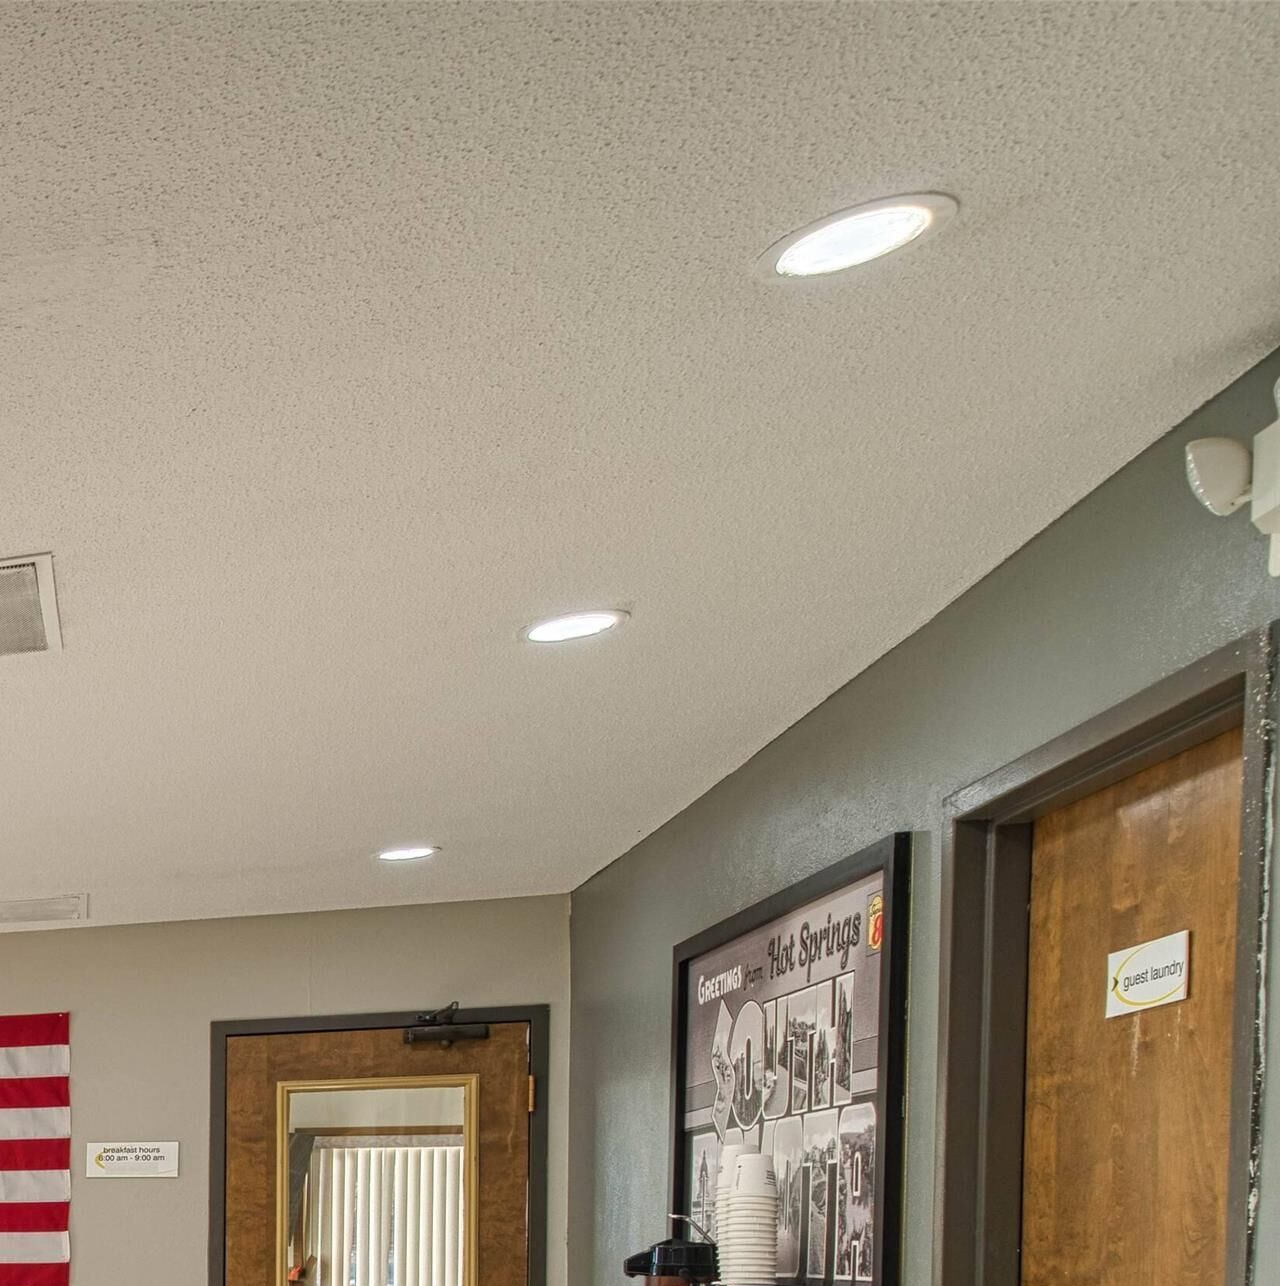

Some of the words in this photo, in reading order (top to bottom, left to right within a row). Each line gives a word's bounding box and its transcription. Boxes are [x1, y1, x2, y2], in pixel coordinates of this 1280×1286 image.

[698, 965, 742, 1005] GREETINGS
[743, 962, 763, 991] from
[768, 934, 795, 980] Hot
[799, 911, 862, 983] Springs
[1123, 969, 1148, 992] guest
[1150, 960, 1184, 981] laundry
[711, 970, 855, 1143] SOUTH
